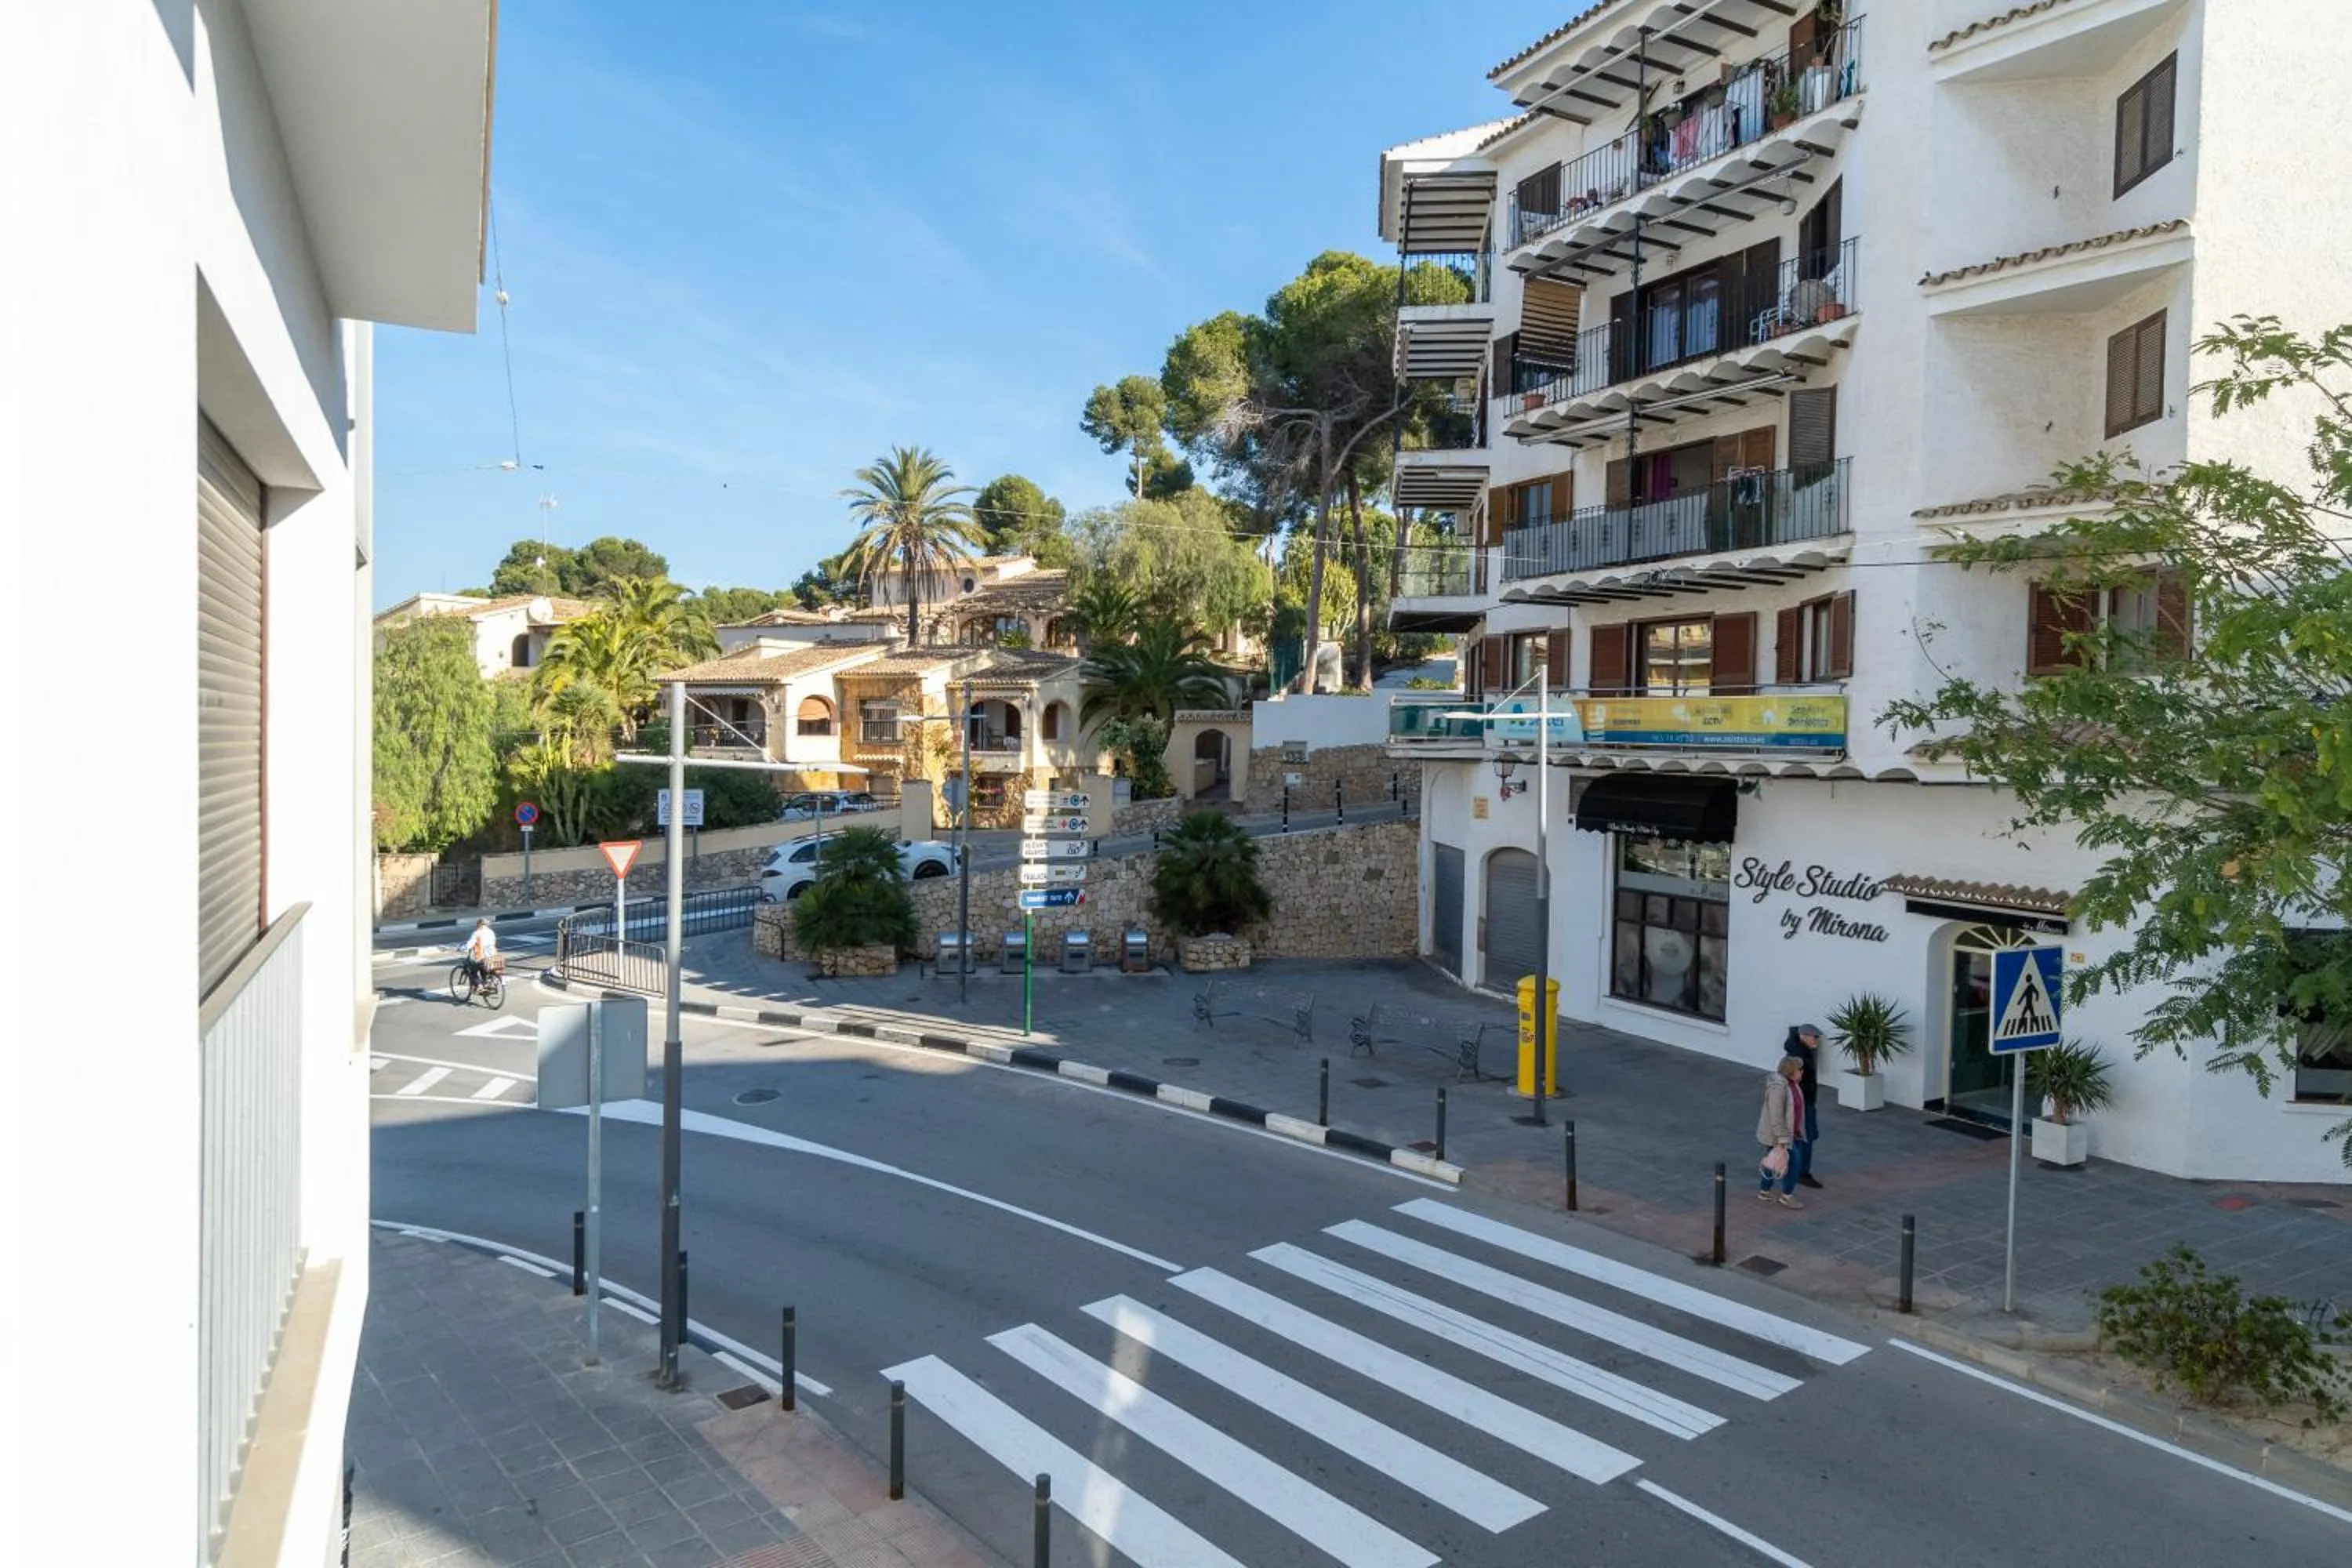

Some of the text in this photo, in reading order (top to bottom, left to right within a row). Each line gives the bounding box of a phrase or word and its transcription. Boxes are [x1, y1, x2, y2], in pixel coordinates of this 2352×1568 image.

[1734, 857, 1795, 903] Style
[1796, 865, 1882, 902] Studio
[1780, 906, 1889, 942] by Mirona
